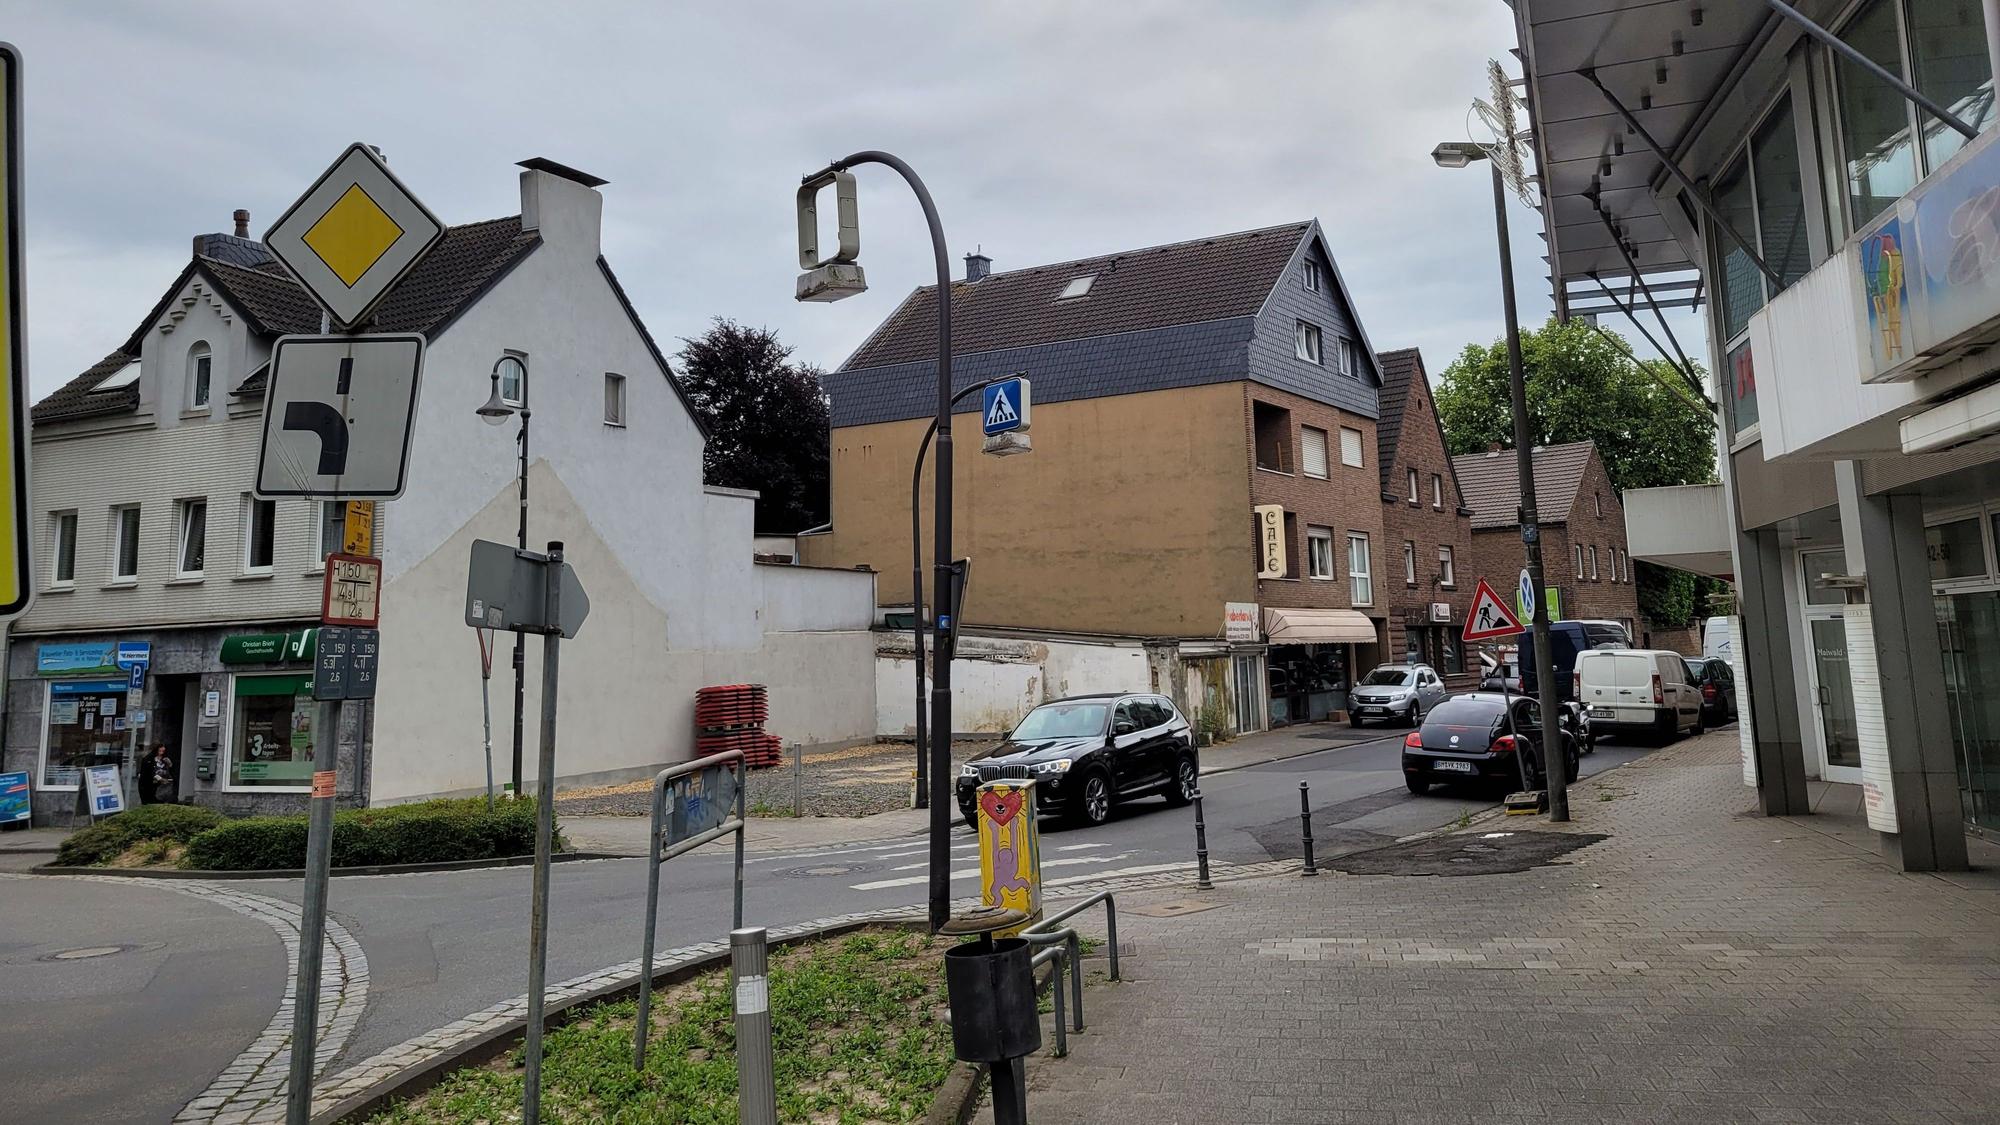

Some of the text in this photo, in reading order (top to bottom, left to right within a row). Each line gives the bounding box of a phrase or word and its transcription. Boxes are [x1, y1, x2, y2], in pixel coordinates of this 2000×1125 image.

[1266, 511, 1278, 571] CAFE
[321, 643, 346, 653] S 150
[351, 643, 376, 653] S 150
[251, 734, 263, 757] 3
